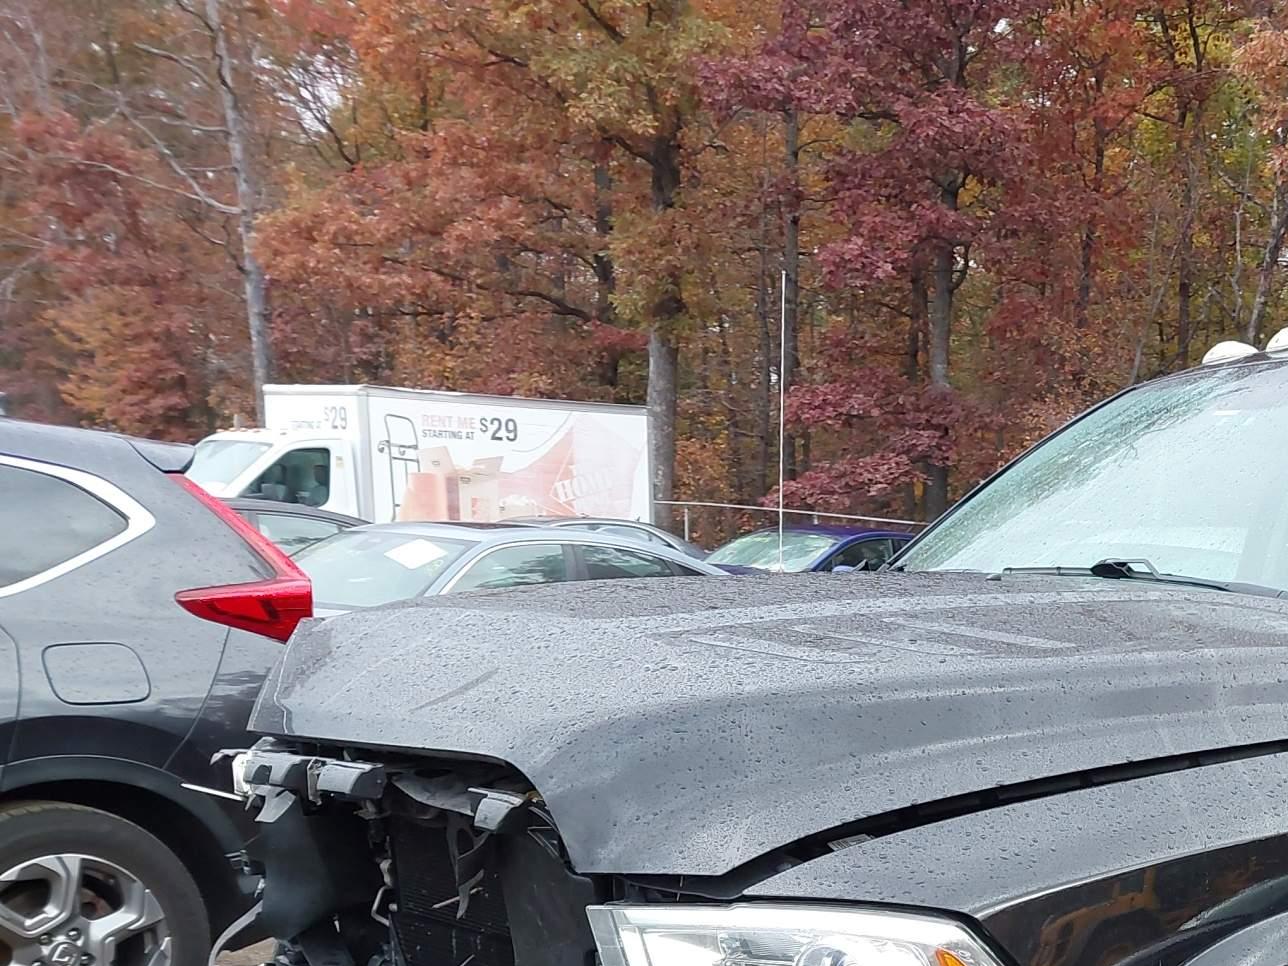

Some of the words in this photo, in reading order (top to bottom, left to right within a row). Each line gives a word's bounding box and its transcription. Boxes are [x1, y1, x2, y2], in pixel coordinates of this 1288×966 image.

[422, 428, 463, 440] STARTING
[466, 431, 475, 440] AT
[480, 417, 518, 442] $29
